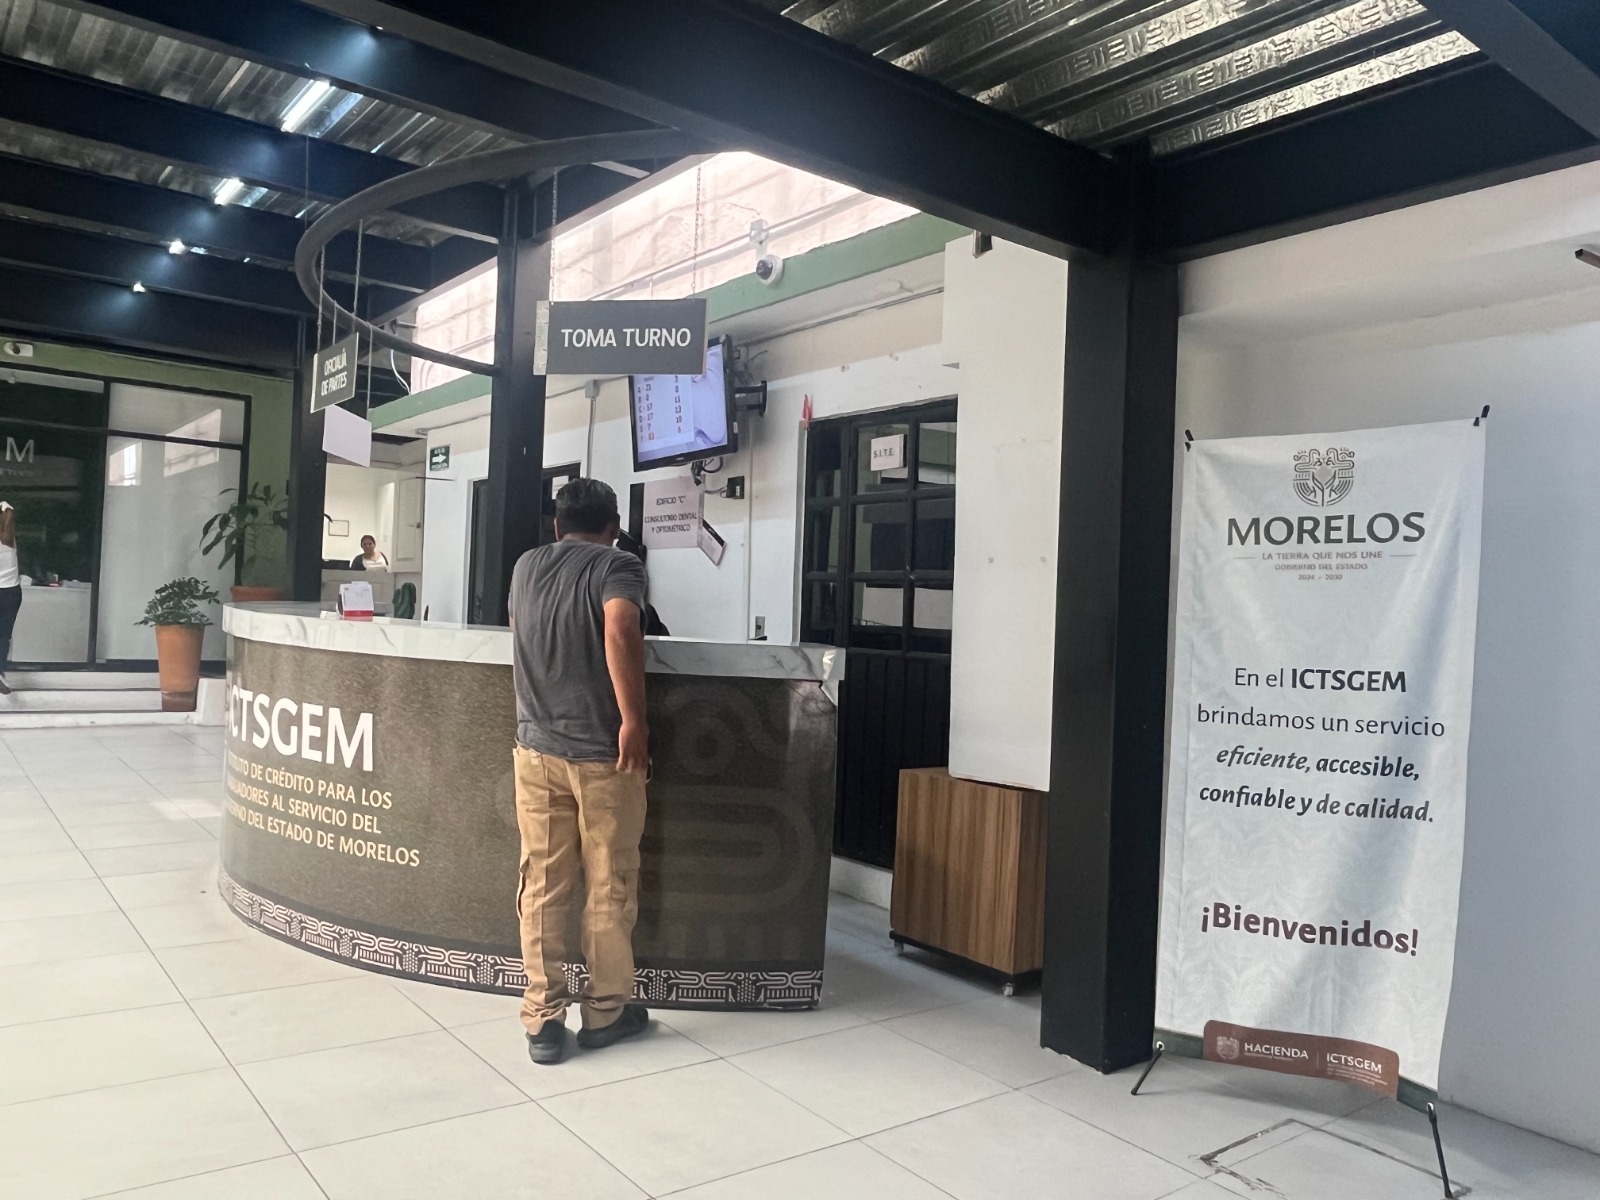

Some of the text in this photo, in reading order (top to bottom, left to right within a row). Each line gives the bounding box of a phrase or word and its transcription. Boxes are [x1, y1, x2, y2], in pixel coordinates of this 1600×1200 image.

[561, 327, 691, 348] TOMA TURNO
[321, 371, 347, 396] DE PARTES
[5, 436, 34, 463] M
[645, 513, 698, 523] CONSULTORIO DENTAL
[1227, 512, 1425, 546] MORELOS
[1274, 563, 1316, 571] GOBIERNO
[1276, 552, 1309, 560] TIERRA
[1312, 552, 1333, 560] QUE
[1361, 551, 1383, 559] UNE
[1234, 668, 1407, 692] En el ICTSGEM
[1197, 703, 1445, 737] brindamos un servicio
[1216, 745, 1420, 781] eficiente, accesible,
[250, 762, 263, 781] DE
[265, 767, 314, 794] CRÉDITO
[317, 779, 356, 804] PARA
[361, 788, 393, 810] LOS
[271, 794, 285, 812] AL
[288, 798, 347, 827] SERVICIO
[352, 813, 382, 834] DEL
[1199, 785, 1434, 823] confiable y de calidad.
[247, 809, 265, 830] DEL
[267, 816, 313, 844] ESTADO
[316, 830, 335, 850] DE
[339, 836, 420, 867] MORELOS
[1201, 902, 1419, 957] ¡Bienvenidos!
[1244, 1042, 1309, 1060] HACIENDA
[1326, 1052, 1382, 1074] ICTSGEM
